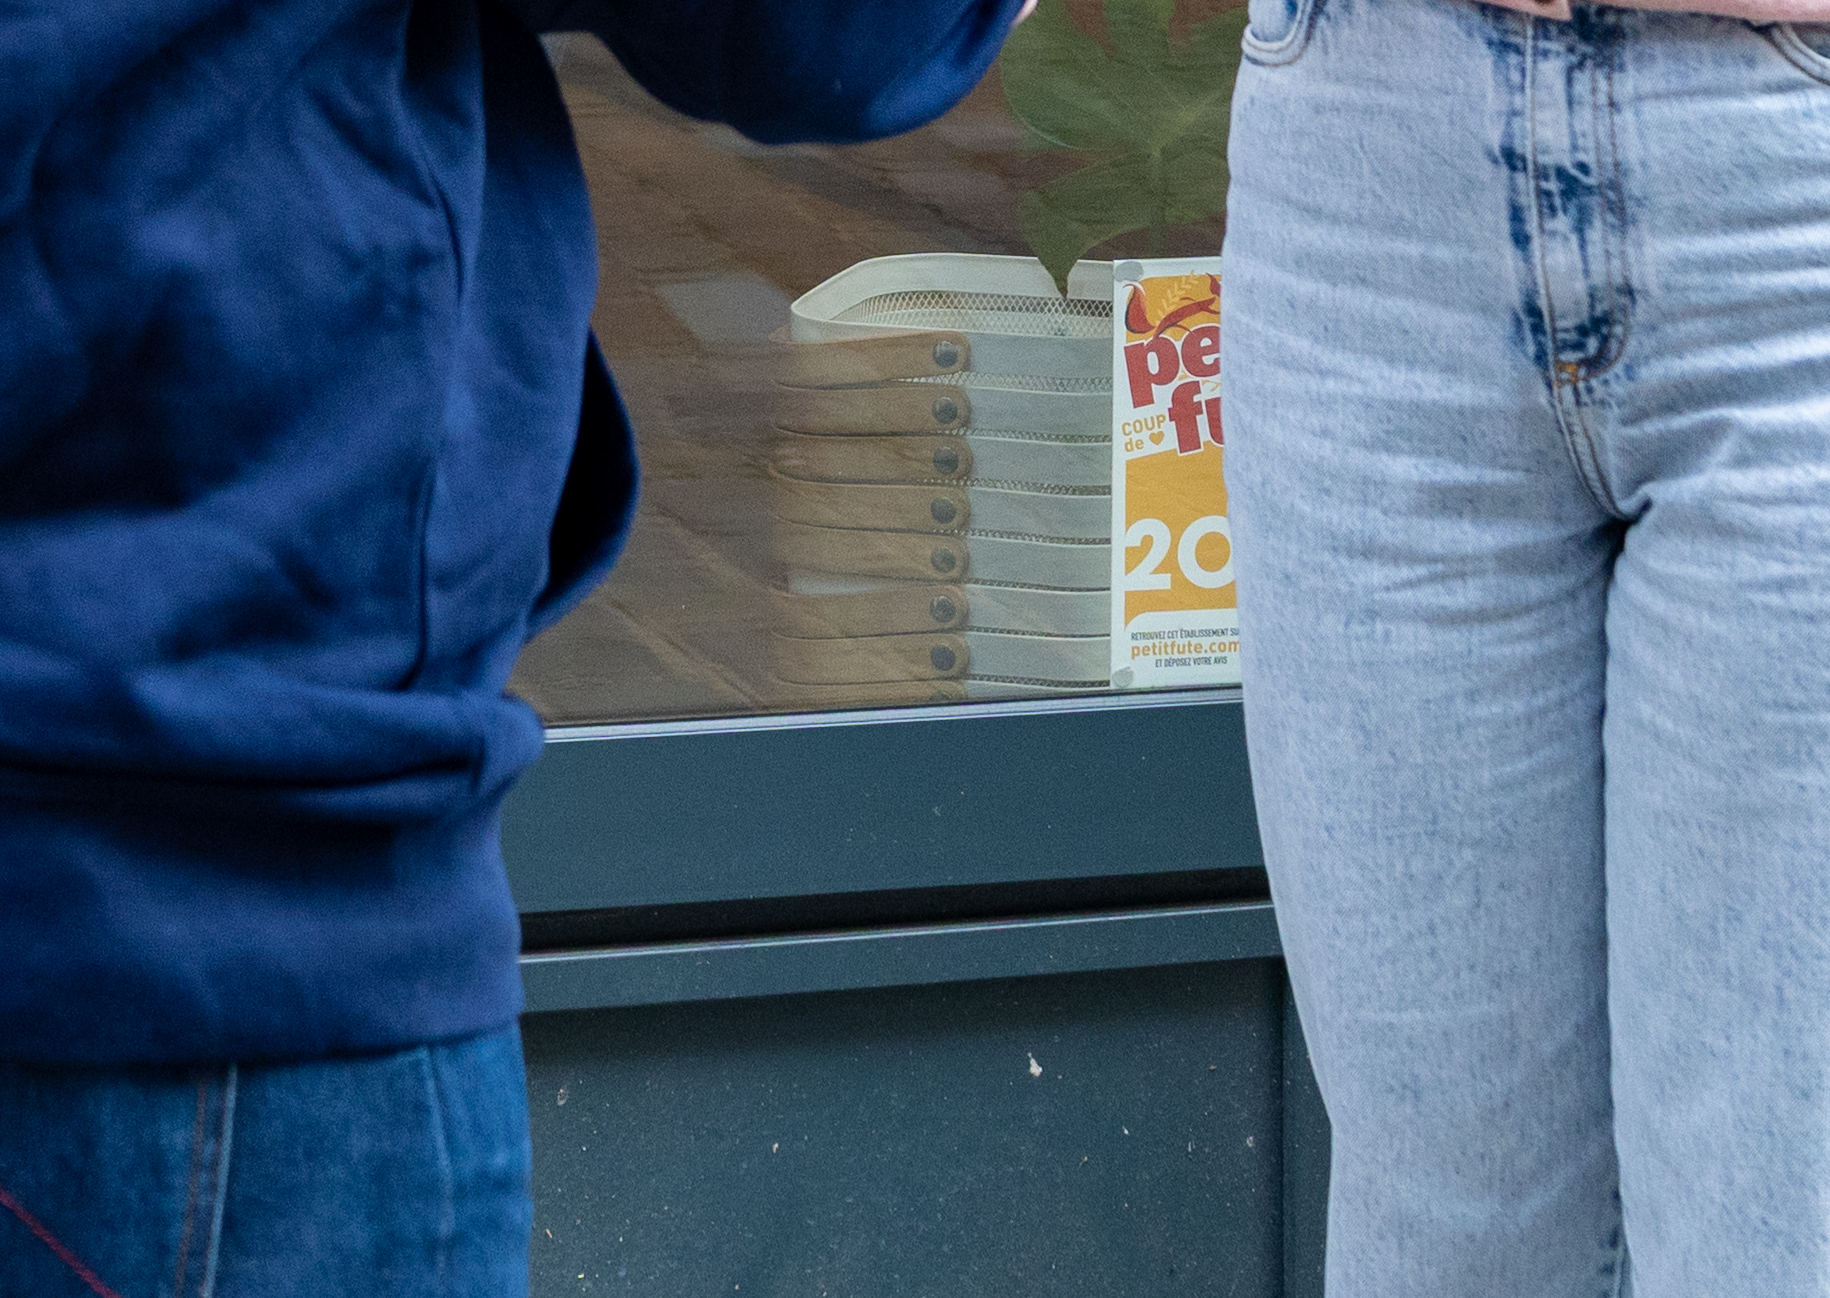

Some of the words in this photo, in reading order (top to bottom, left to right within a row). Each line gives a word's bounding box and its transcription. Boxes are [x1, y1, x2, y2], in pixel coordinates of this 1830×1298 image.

[1122, 414, 1166, 436] COUP
[1124, 437, 1145, 452] de
[1125, 515, 1235, 590] 20
[1131, 631, 1166, 641] RETROUVEZ
[1167, 630, 1179, 639] CET
[1131, 640, 1240, 660] petitfute.com
[1193, 657, 1212, 666] VOTRE
